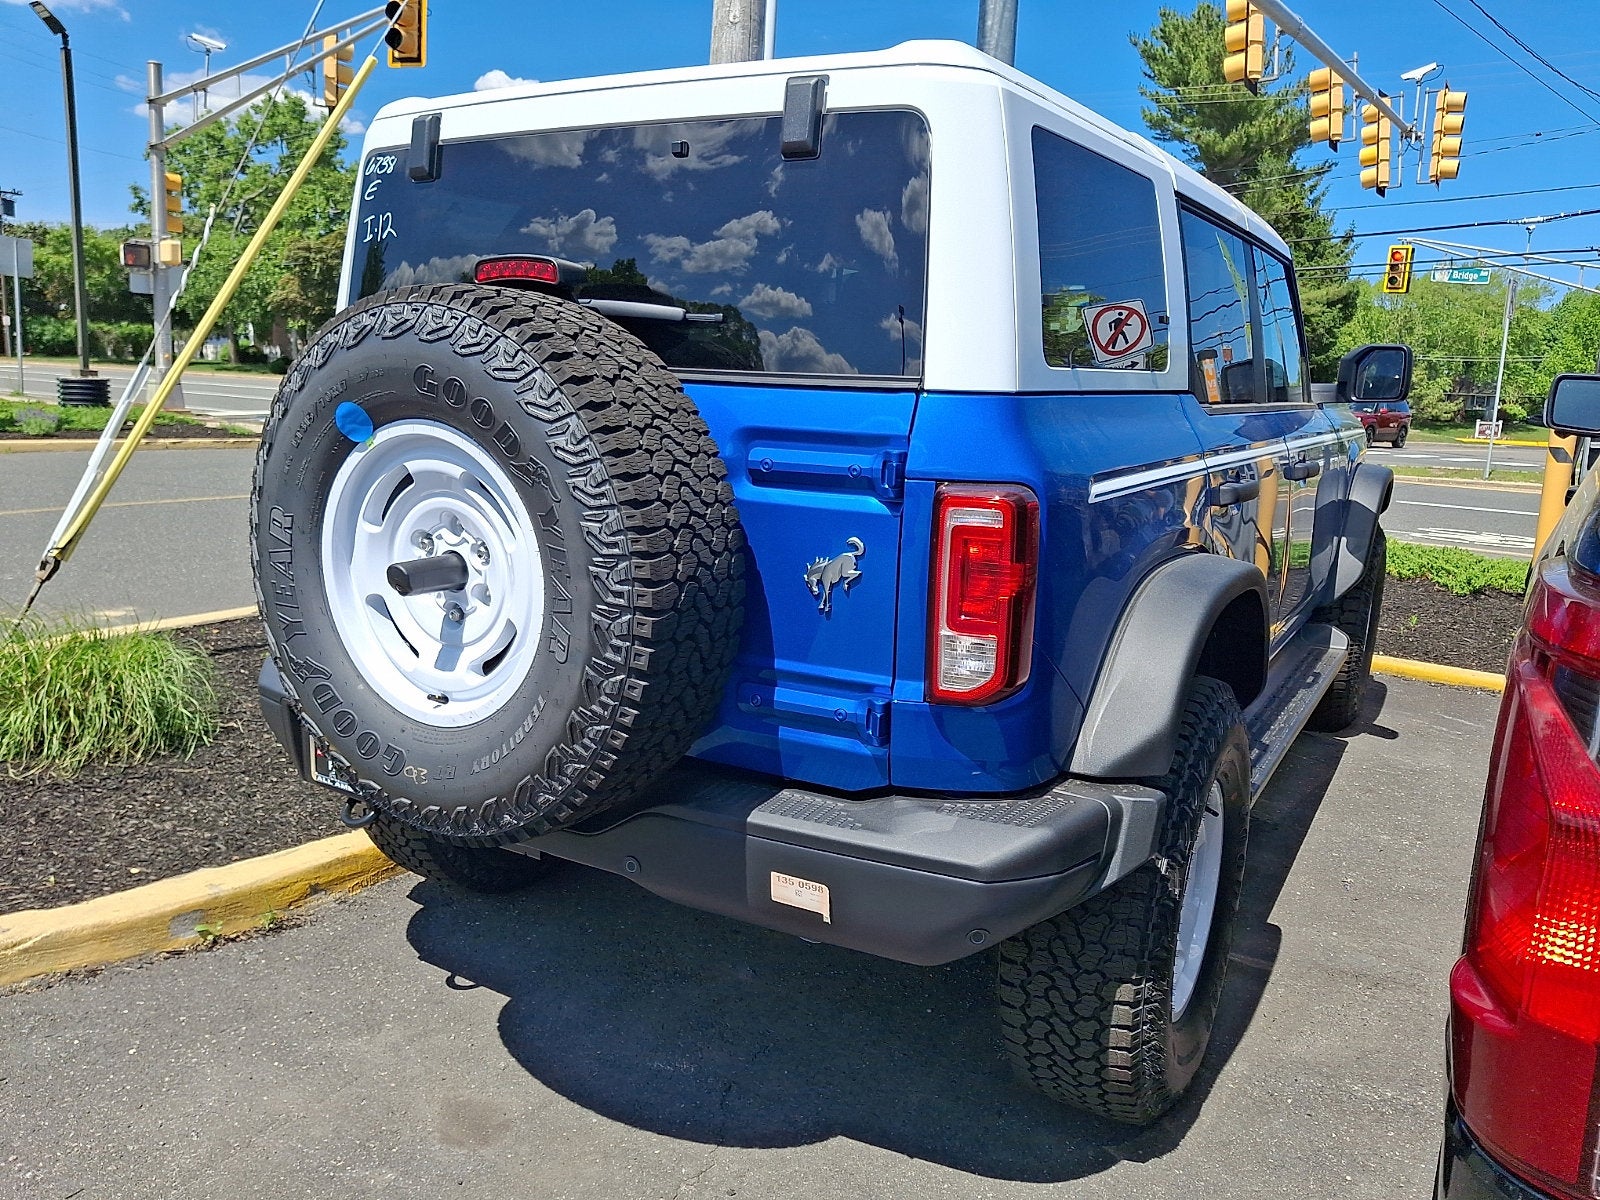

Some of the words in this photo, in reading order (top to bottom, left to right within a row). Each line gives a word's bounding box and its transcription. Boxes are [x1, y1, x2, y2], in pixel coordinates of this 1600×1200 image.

[364, 179, 383, 201] E
[1453, 270, 1479, 282] Bridge
[469, 694, 547, 776] TERRITORY
[776, 875, 795, 886] 135
[798, 880, 824, 894] 0598
